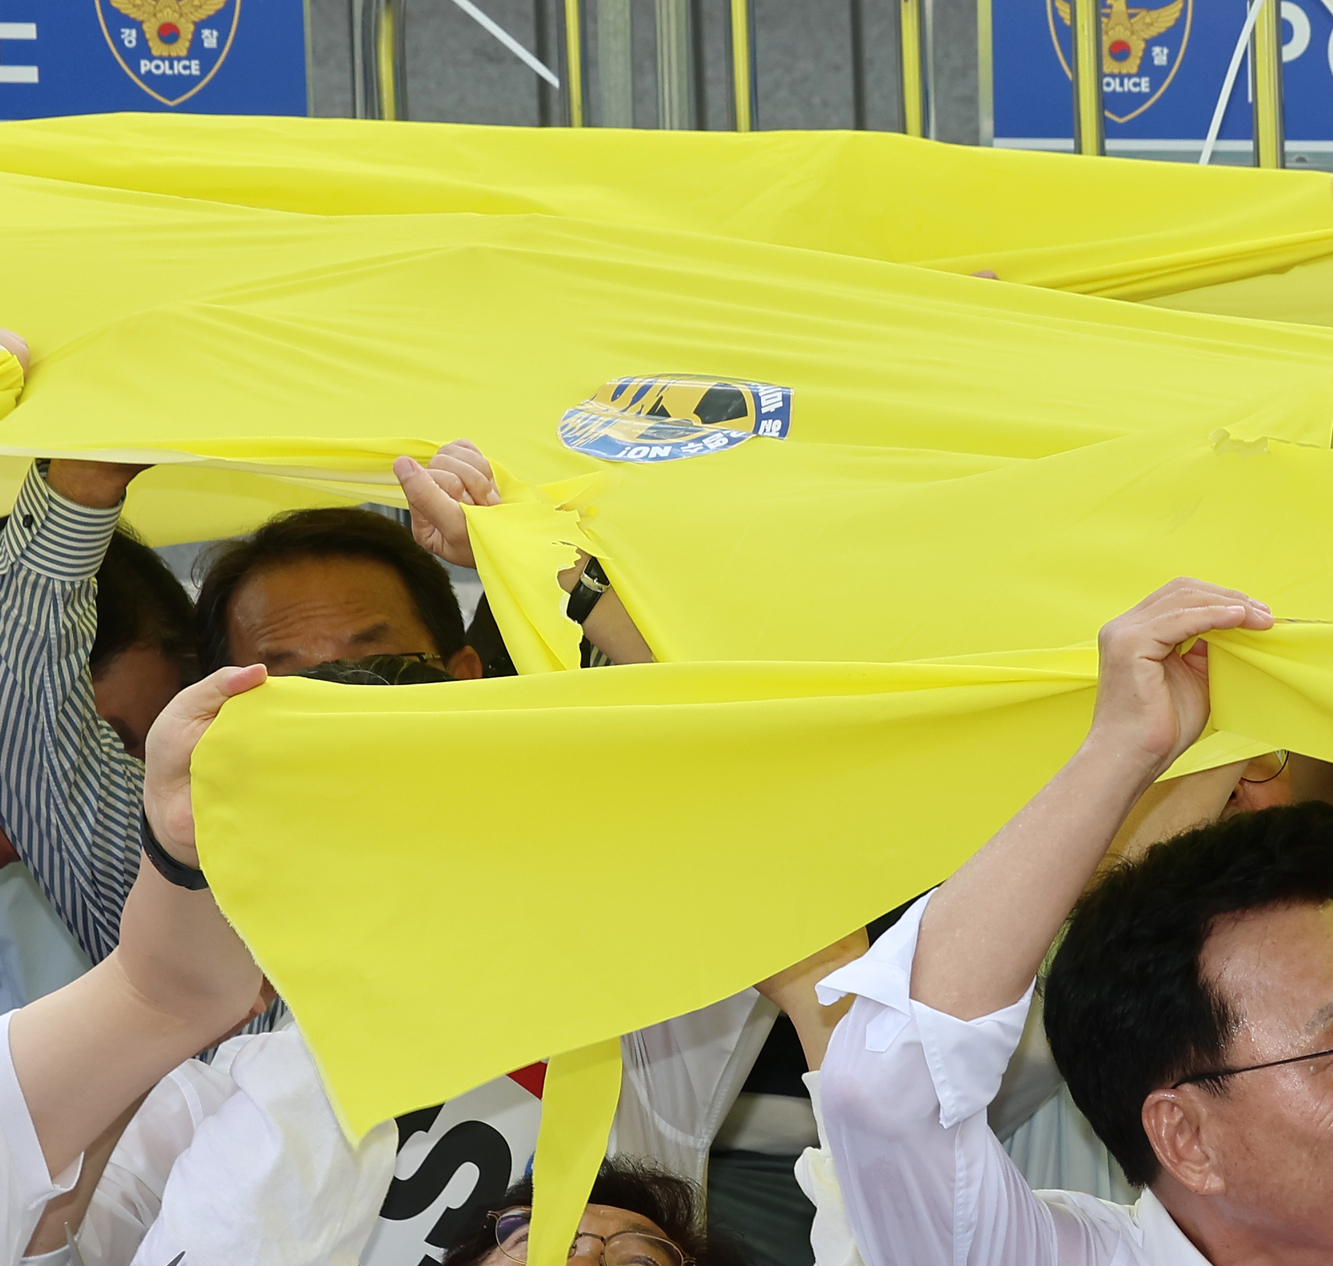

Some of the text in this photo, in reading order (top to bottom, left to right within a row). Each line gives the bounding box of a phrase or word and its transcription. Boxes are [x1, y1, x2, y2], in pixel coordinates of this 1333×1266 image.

[121, 28, 219, 49] 경 찰
[1151, 46, 1169, 66] 찰
[140, 59, 201, 76] POLICE
[1102, 77, 1150, 93] OLICE
[615, 445, 672, 460] NO!
